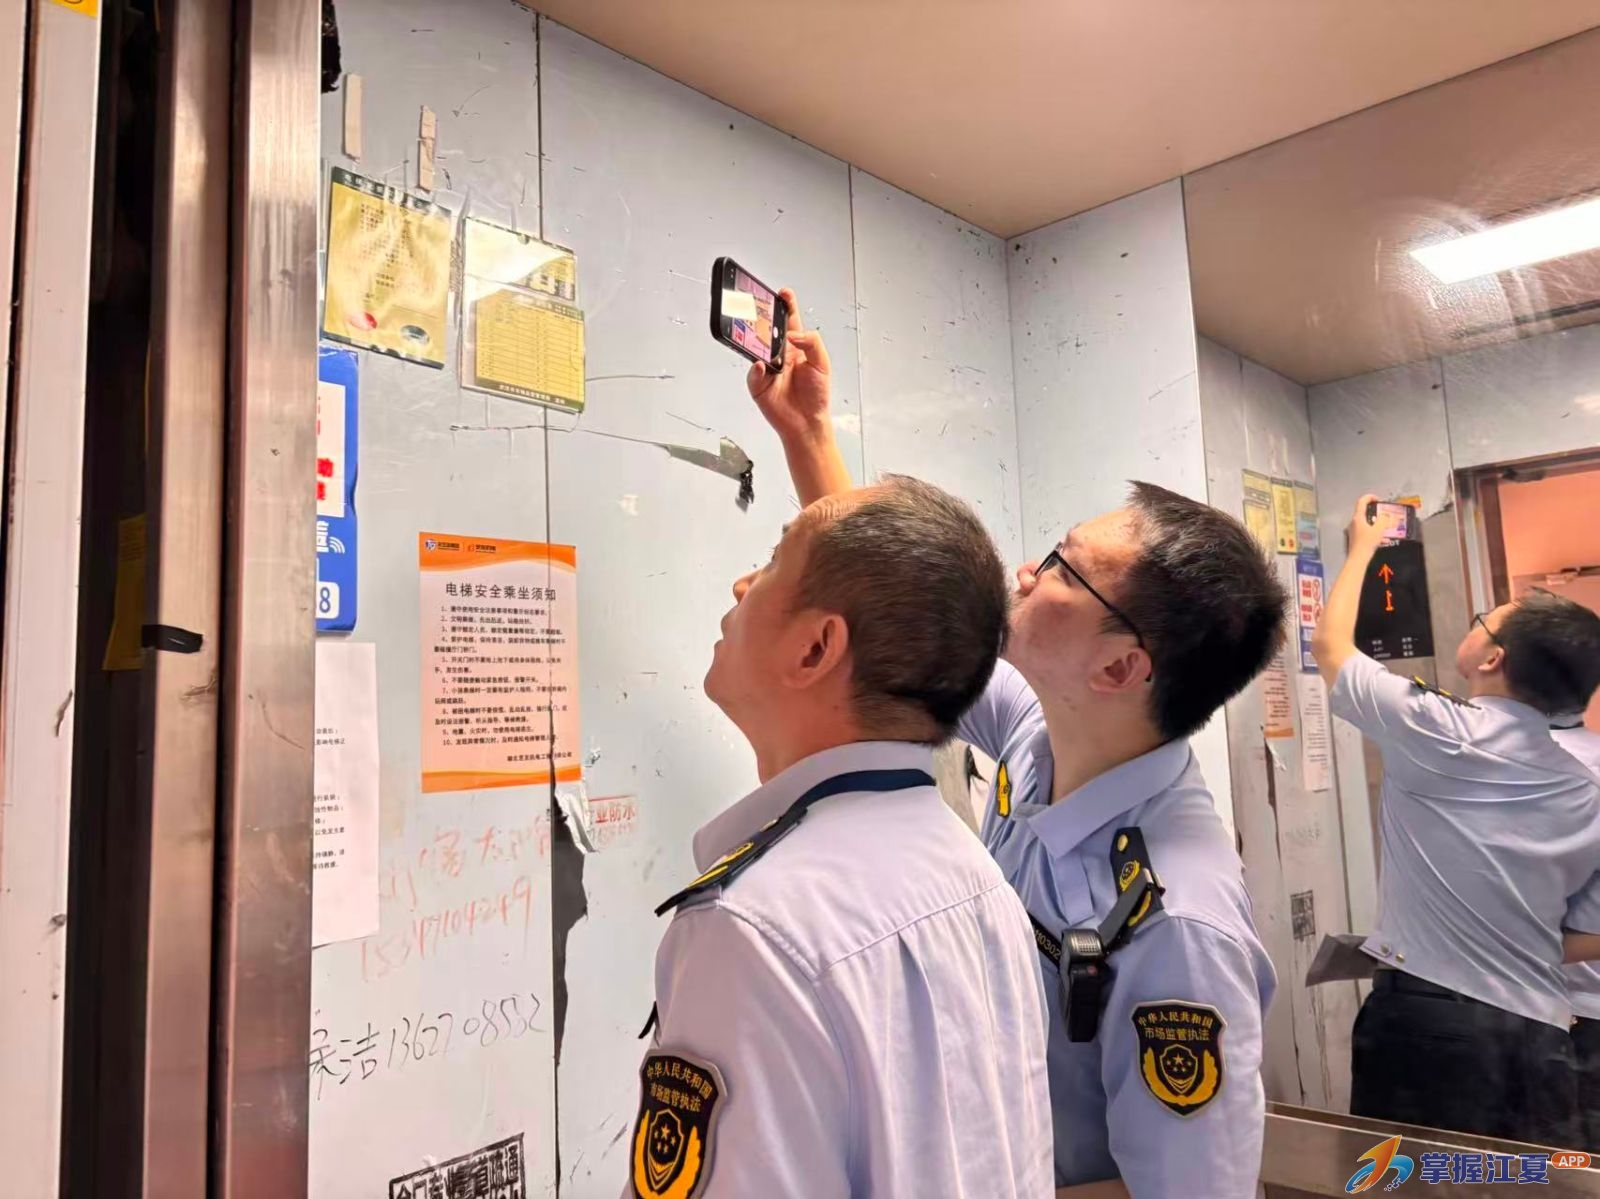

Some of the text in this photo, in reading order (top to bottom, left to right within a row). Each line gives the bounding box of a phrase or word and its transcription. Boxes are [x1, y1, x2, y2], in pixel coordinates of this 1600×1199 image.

[446, 582, 557, 601] 电梯安全乘坐须知
[1138, 1010, 1214, 1029] 中华人民共和国
[1144, 1026, 1210, 1041] 市场监管执法
[646, 1060, 713, 1100] 中华人民共和国
[650, 1082, 702, 1113] 市场监管执法
